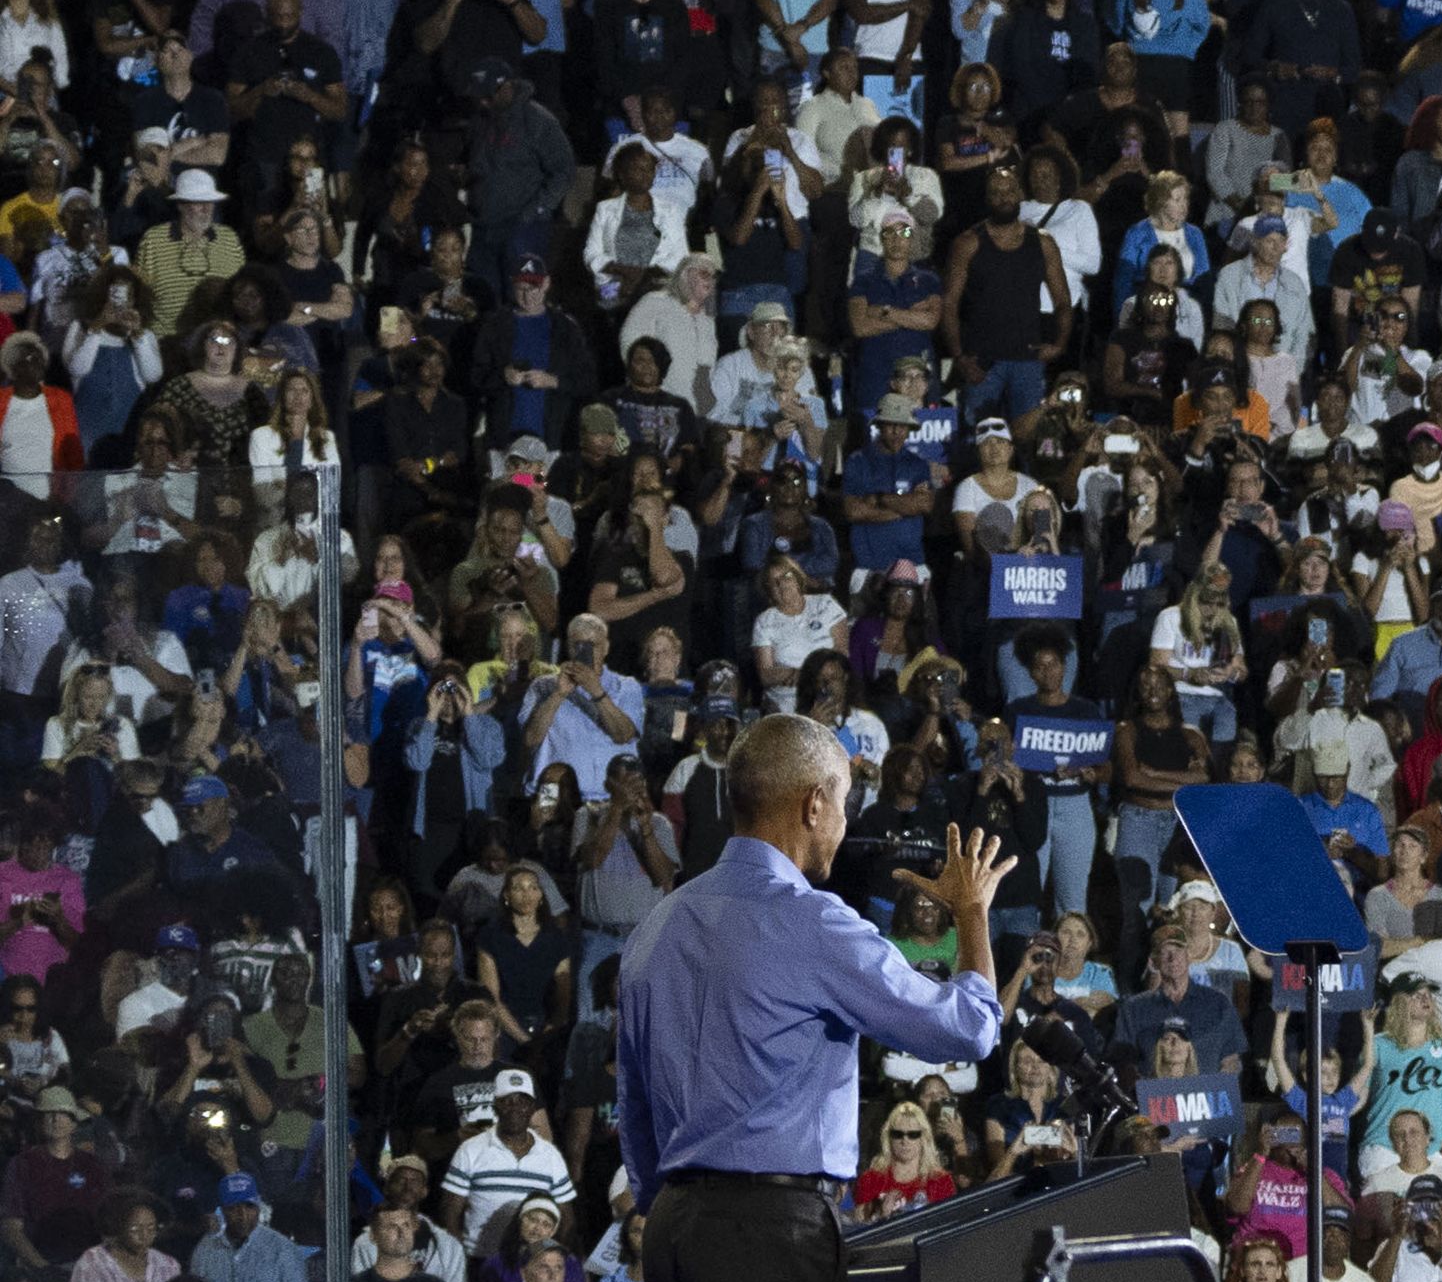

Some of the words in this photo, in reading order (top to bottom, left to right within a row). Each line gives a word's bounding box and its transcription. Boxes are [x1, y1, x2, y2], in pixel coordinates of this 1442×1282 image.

[1004, 565, 1067, 592] HARRIS
[1012, 589, 1057, 606] WALZ
[1021, 724, 1107, 754] FREEDOM
[1148, 1091, 1235, 1124] KAMALA
